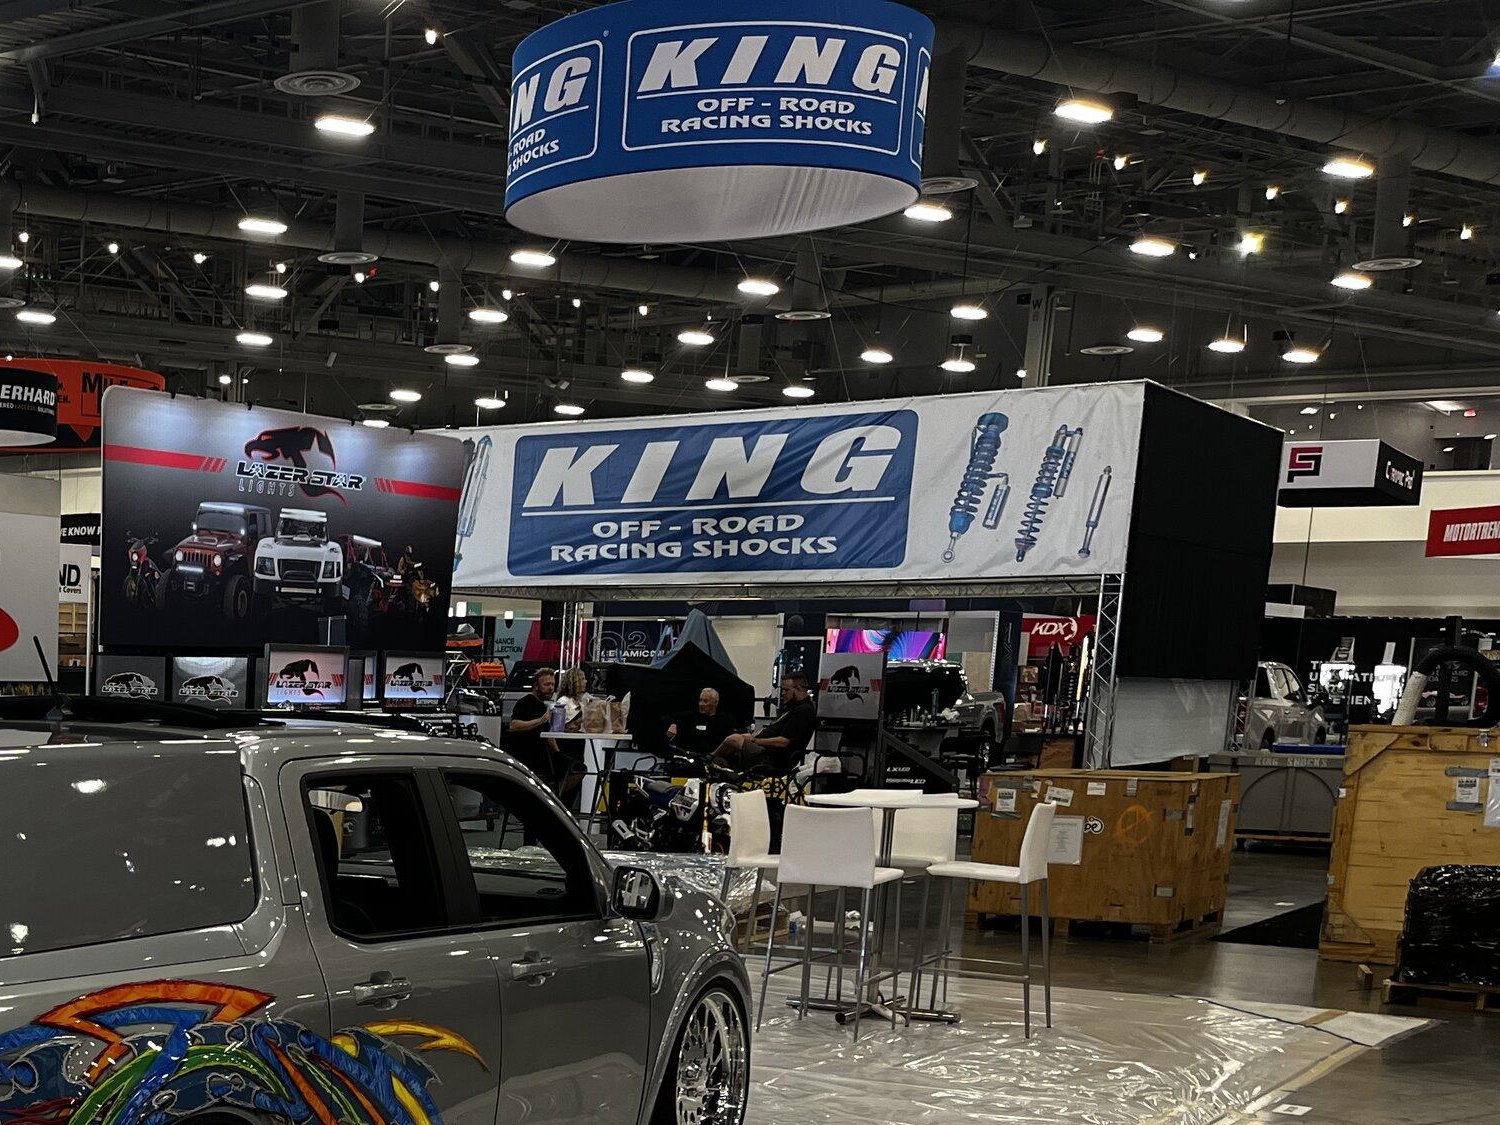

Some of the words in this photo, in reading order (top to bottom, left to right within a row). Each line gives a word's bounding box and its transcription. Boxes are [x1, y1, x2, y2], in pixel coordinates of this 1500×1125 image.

[637, 36, 901, 95] KING
[511, 57, 592, 133] NG
[661, 116, 772, 134] RACING
[778, 115, 872, 135] SHOCKS
[512, 139, 560, 172] SHOCKS
[523, 425, 902, 508] KING
[238, 478, 295, 497] LIGHTS
[68, 526, 96, 537] KNOW
[551, 539, 683, 562] RACING
[692, 534, 837, 558] SHOCKS
[63, 586, 81, 594] Covers
[1031, 622, 1069, 635] KDX
[1254, 757, 1278, 766] KING
